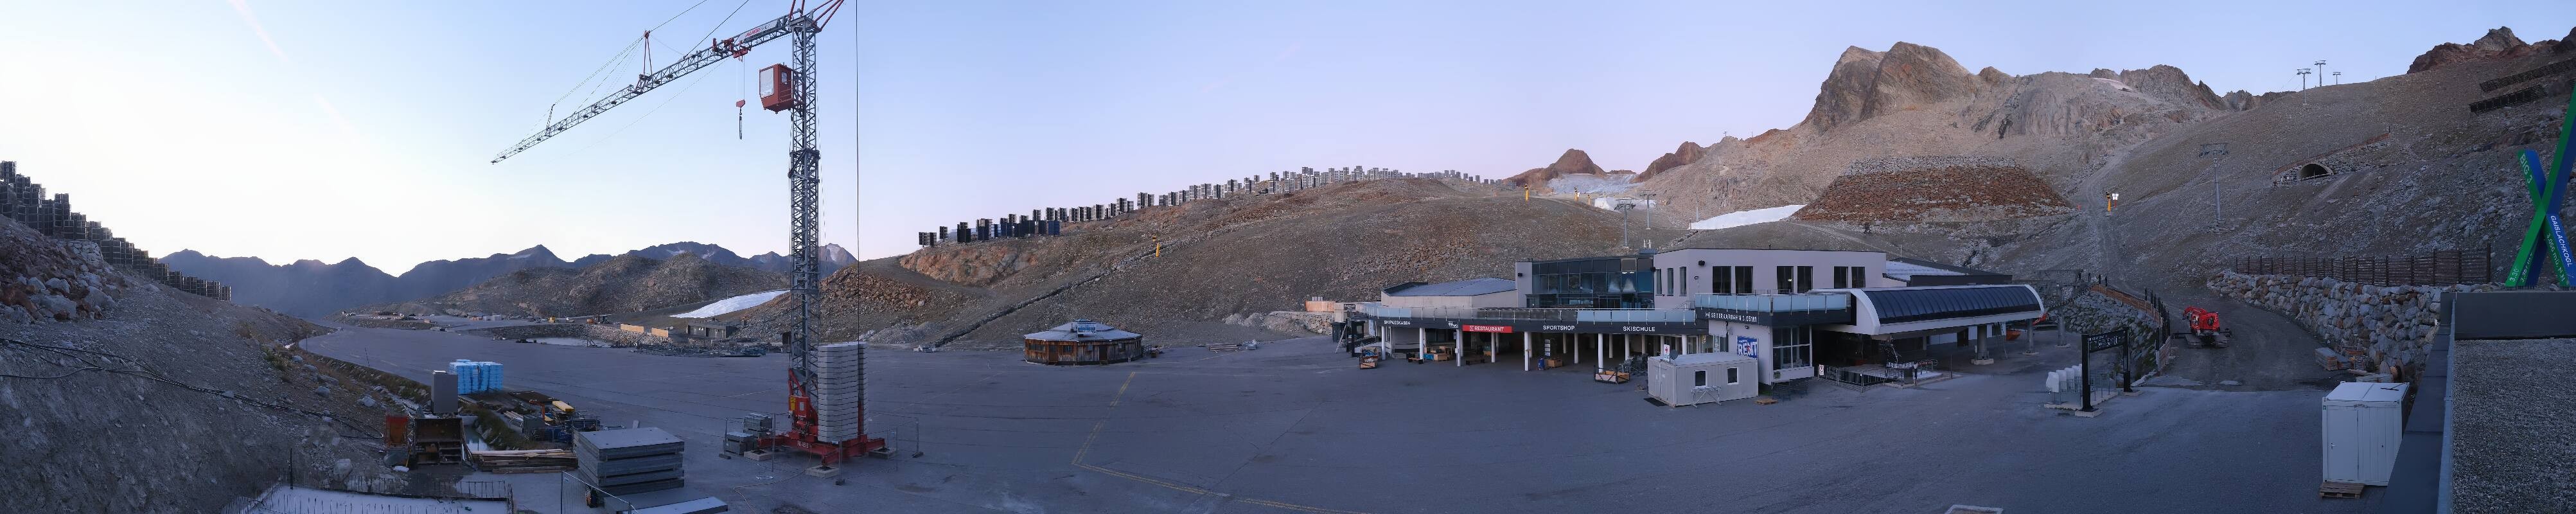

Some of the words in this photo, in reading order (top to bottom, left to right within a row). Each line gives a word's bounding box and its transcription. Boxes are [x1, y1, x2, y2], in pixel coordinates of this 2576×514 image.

[2520, 153, 2530, 175] BIG
[2527, 174, 2532, 184] 3
[2551, 215, 2573, 267] GAISLACHKOGL
